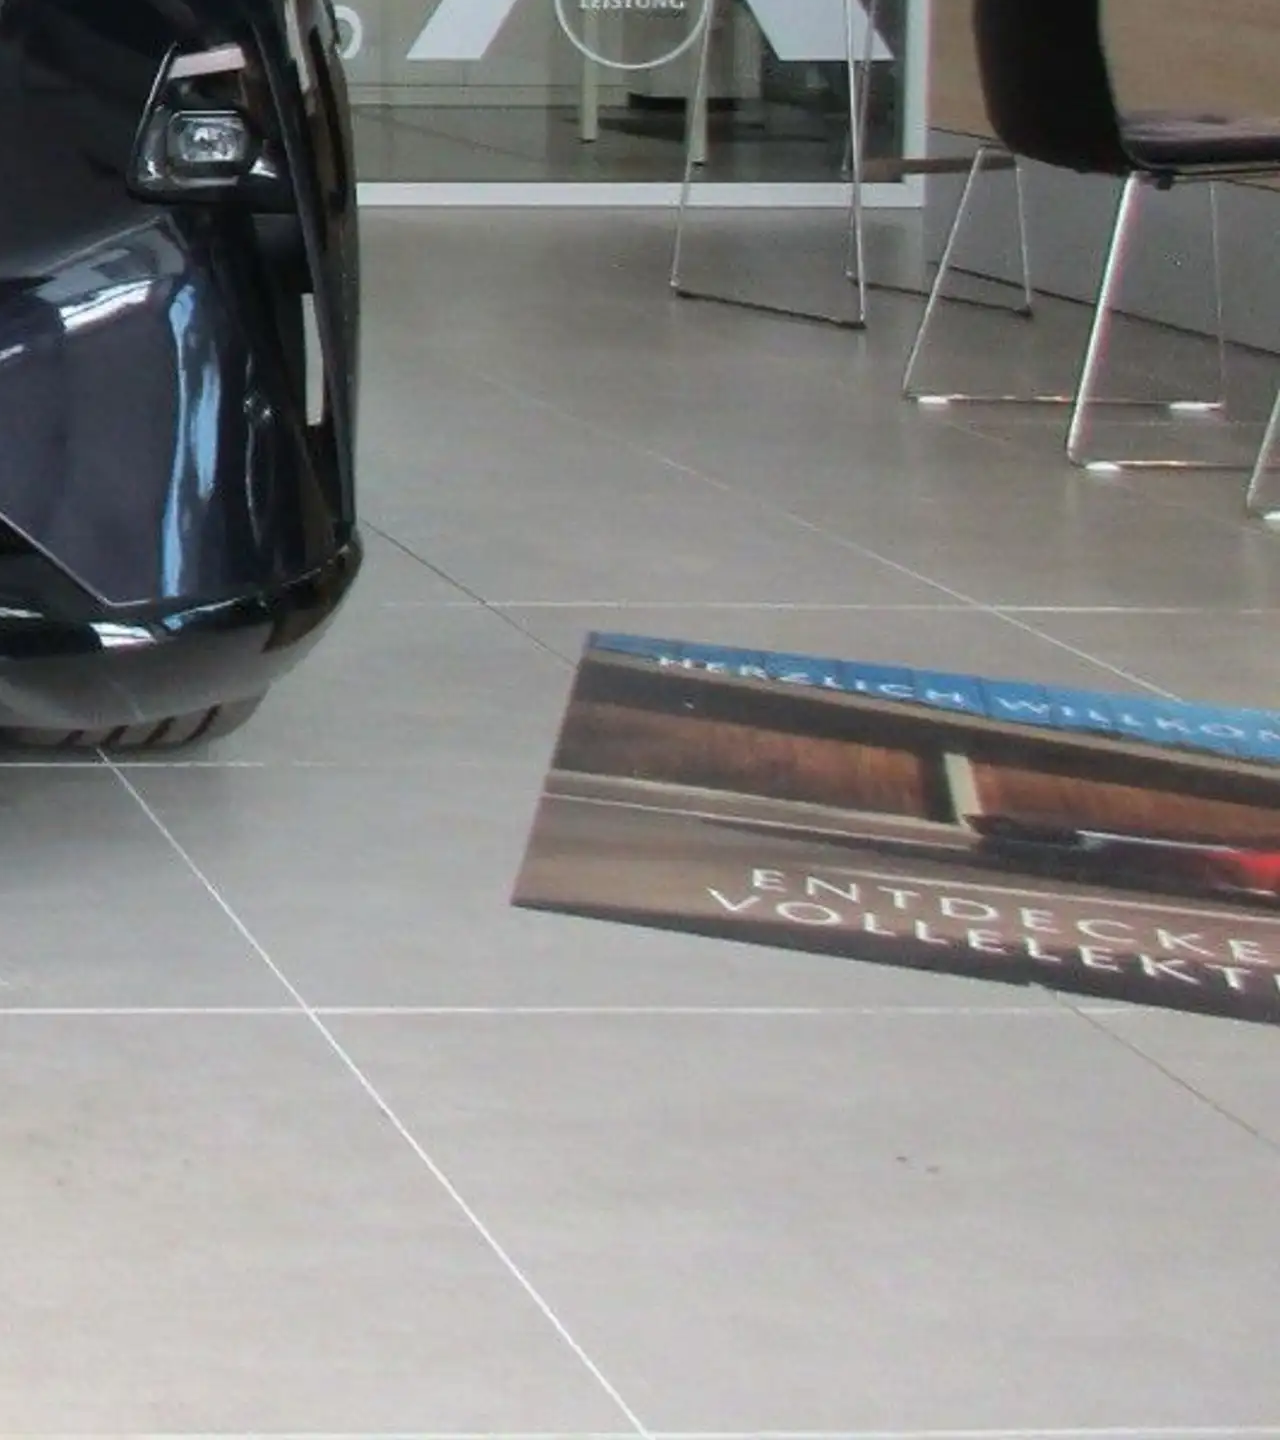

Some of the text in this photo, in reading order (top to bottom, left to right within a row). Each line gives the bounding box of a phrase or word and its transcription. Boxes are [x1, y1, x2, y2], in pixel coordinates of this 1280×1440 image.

[659, 655, 967, 706] HERZLICH
[708, 887, 1280, 1002] VOLLELEKT
[752, 867, 1270, 965] ENTDECKE
